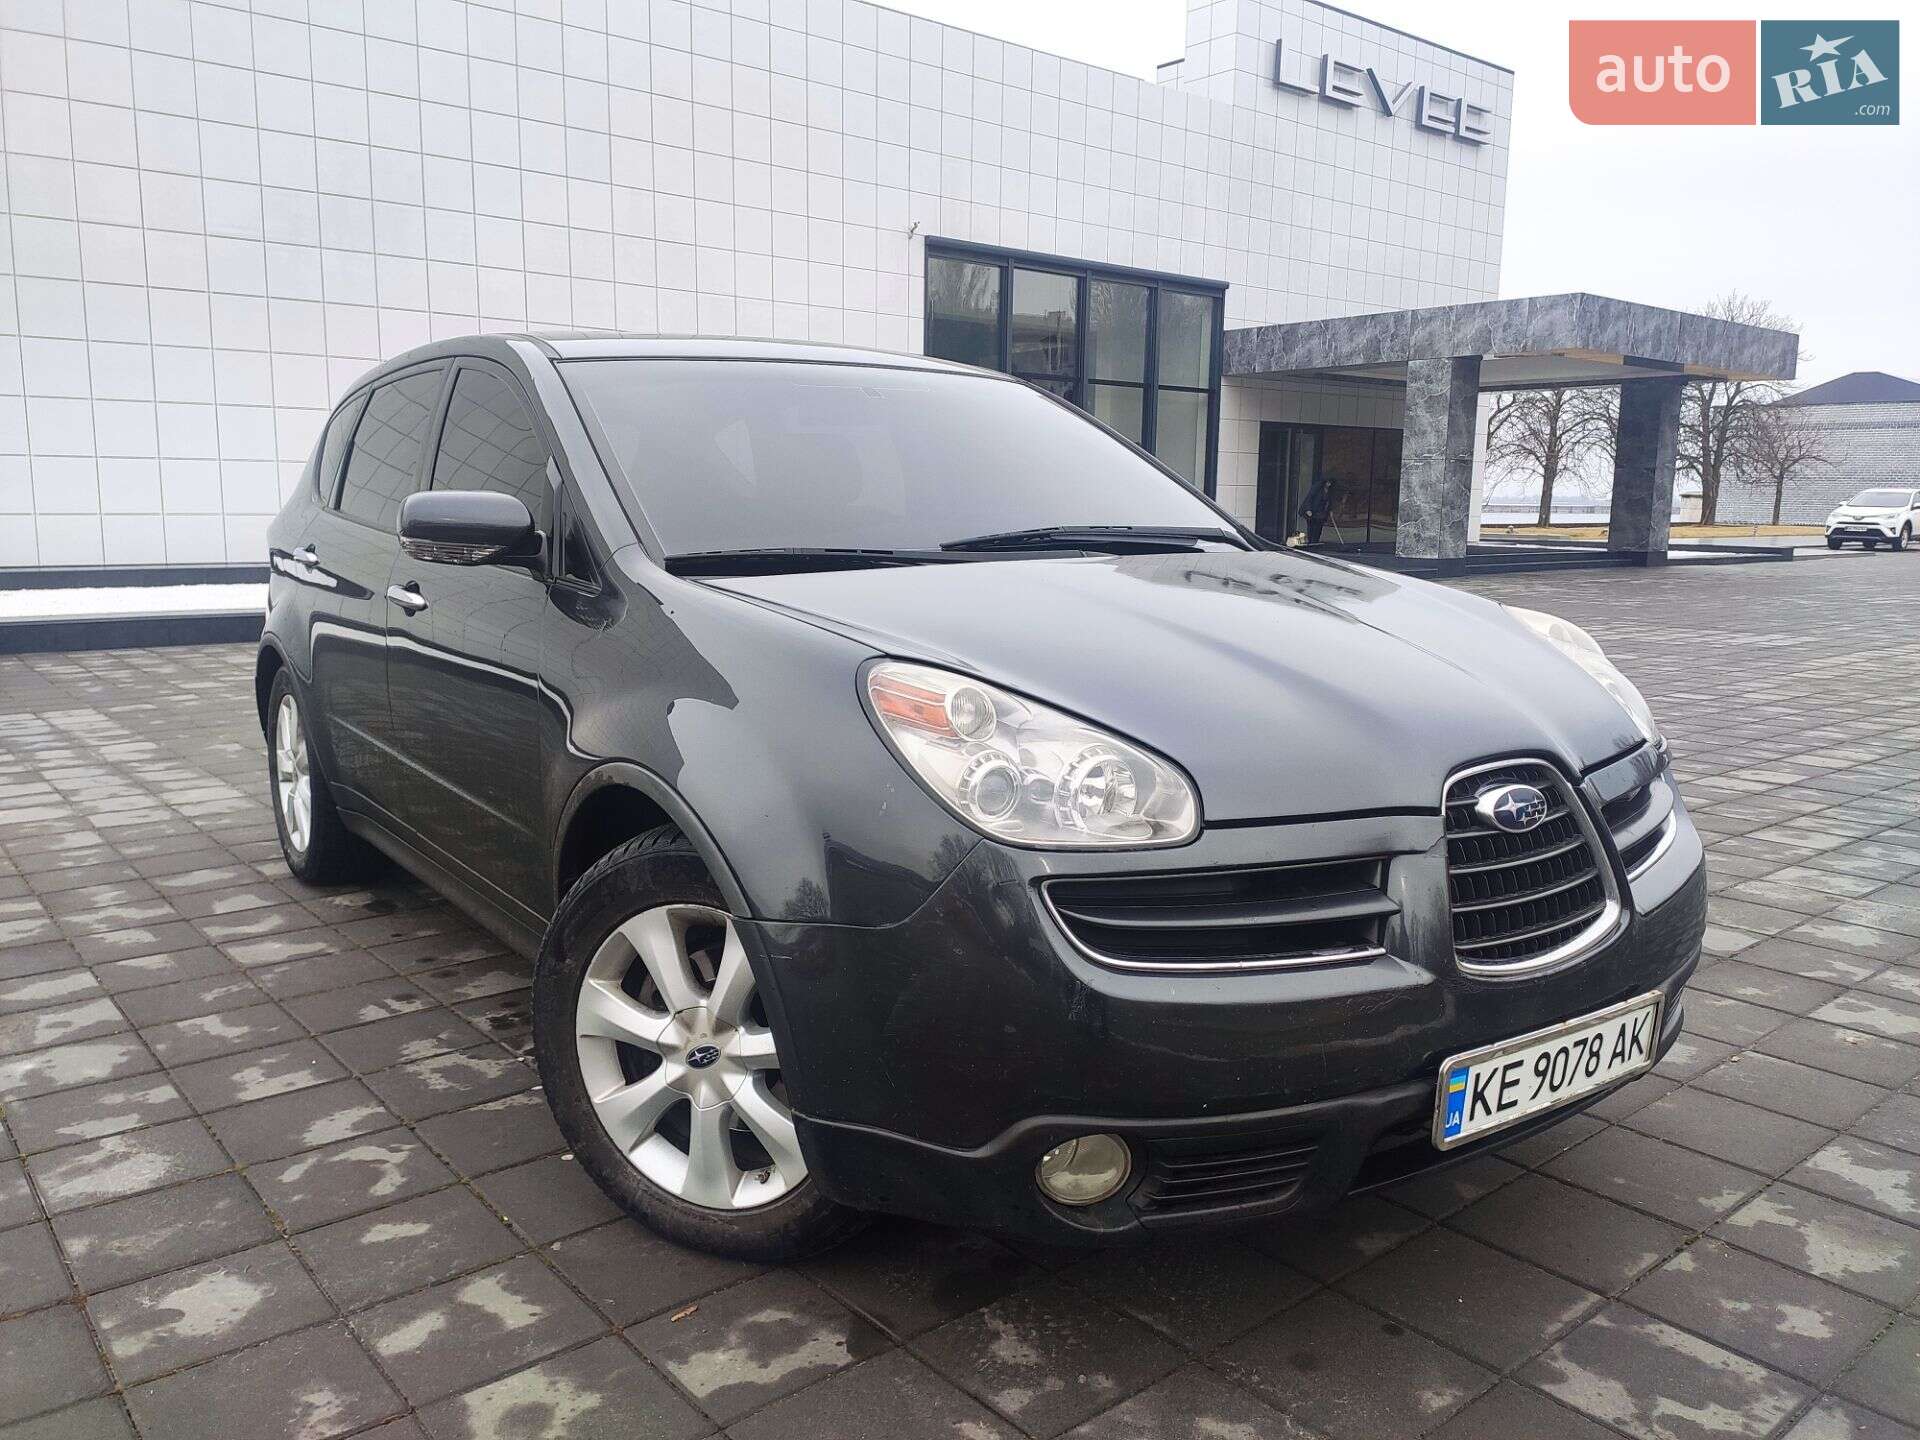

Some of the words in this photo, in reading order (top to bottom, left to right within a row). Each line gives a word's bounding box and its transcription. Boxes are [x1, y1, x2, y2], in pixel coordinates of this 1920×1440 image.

[1273, 38, 1494, 145] LEVEE
[1469, 1059, 1524, 1122] KE
[1529, 1032, 1604, 1100] 9078
[1607, 1011, 1651, 1069] AK
